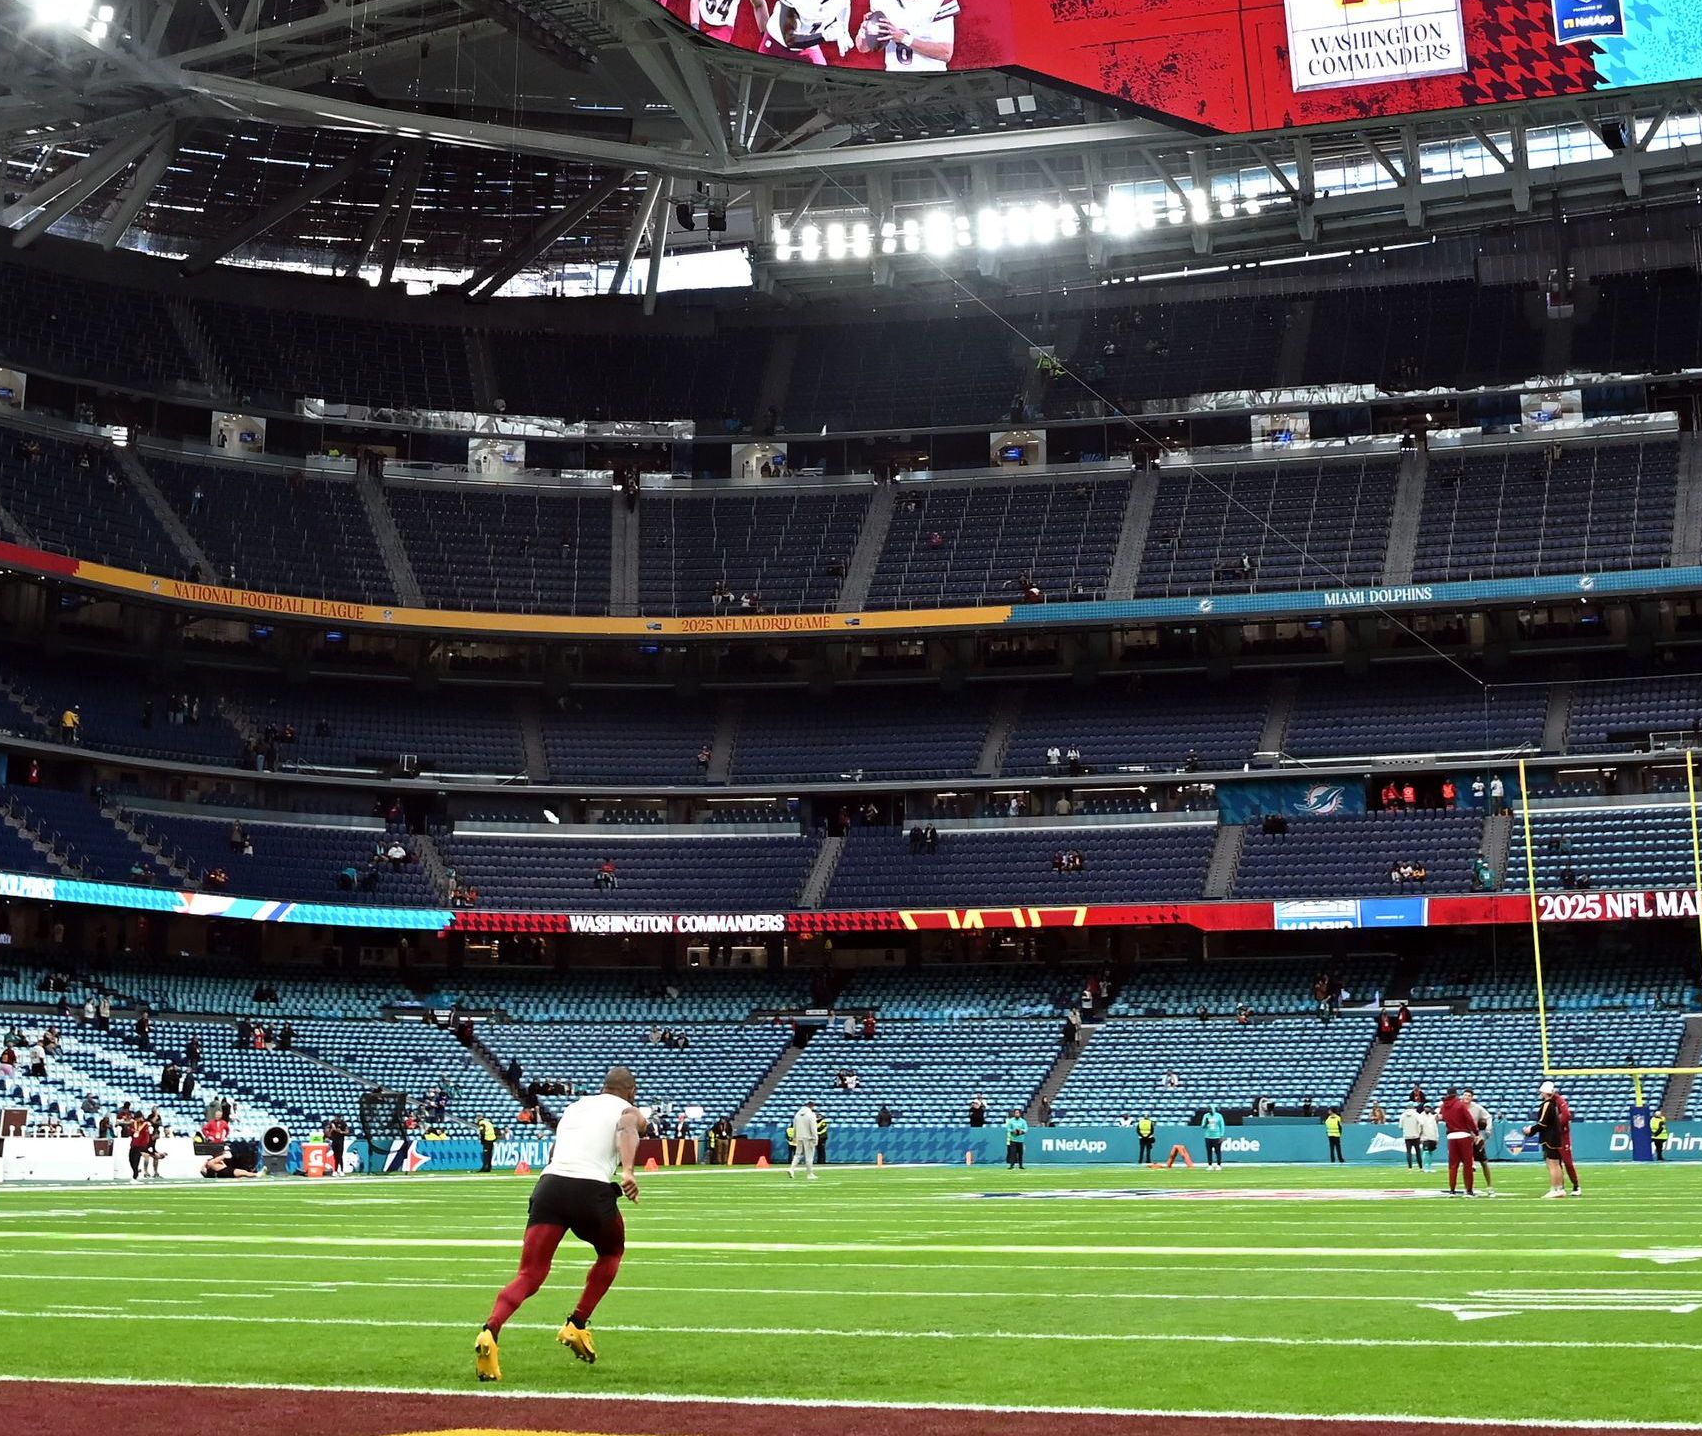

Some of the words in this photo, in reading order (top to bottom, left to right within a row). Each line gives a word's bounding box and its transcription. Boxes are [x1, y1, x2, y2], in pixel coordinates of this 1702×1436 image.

[1576, 14, 1615, 27] NetApp
[1311, 22, 1442, 54] WASHINGTON
[1308, 43, 1451, 76] COMMANDERS
[173, 582, 236, 605] NATIONAL
[241, 592, 307, 613] FOOTBALL
[312, 602, 364, 620] LEAGUE
[1324, 590, 1365, 607] MIAMI
[1370, 587, 1432, 604] DOLPHINS
[681, 619, 713, 632] 2025
[716, 620, 740, 631] NFL
[742, 617, 791, 631] MADRID
[794, 616, 830, 629] GAME
[1537, 893, 1603, 920] 2025
[1606, 892, 1653, 917] NFL
[569, 915, 673, 933] WASHINGTON
[676, 914, 785, 933] COMMANDERS
[491, 1142, 519, 1166] 2025
[520, 1142, 541, 1166] NFL
[1055, 1139, 1107, 1154] NetApp
[1219, 1138, 1260, 1153] dobe
[309, 1149, 323, 1166] G
